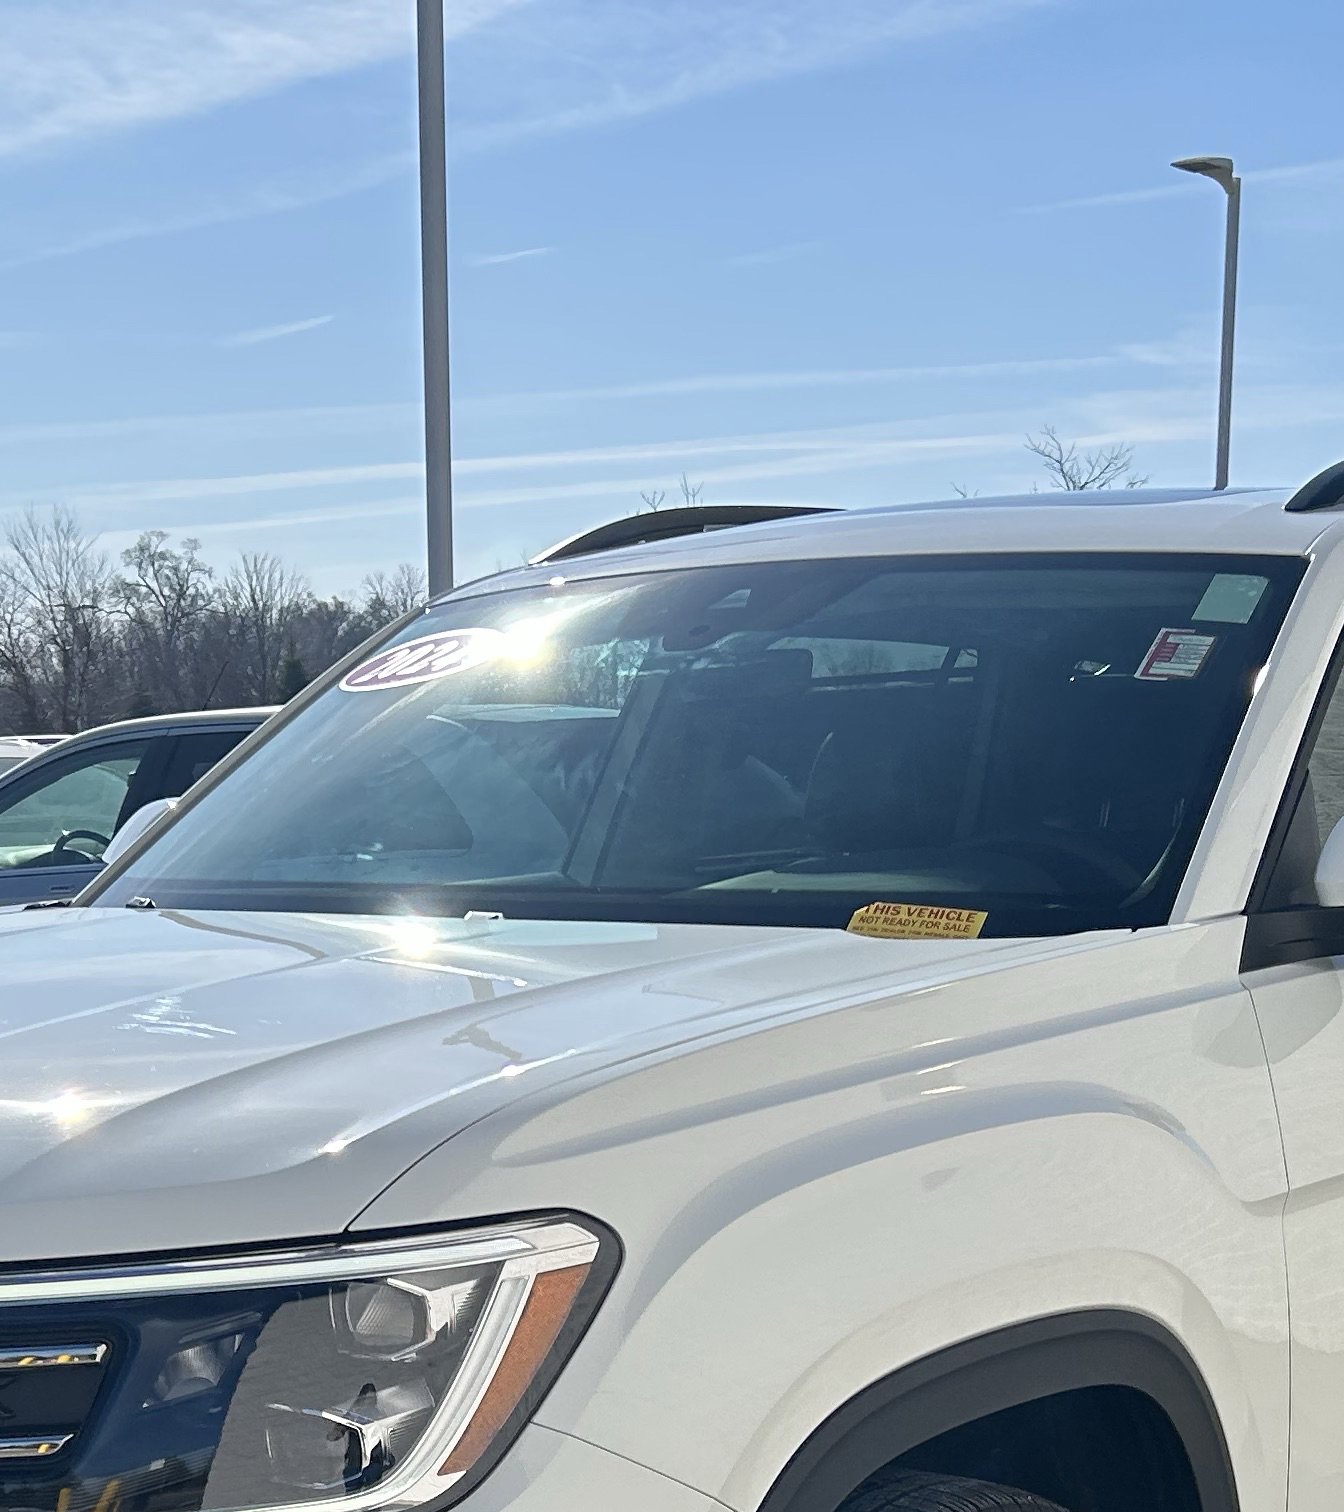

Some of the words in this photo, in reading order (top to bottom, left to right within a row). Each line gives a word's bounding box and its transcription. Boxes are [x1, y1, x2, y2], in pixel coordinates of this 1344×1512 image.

[858, 915, 881, 925] NOT
[882, 916, 917, 928] READY
[918, 919, 942, 930] FOR
[942, 923, 972, 933] SALE
[906, 906, 978, 924] VEHICLE
